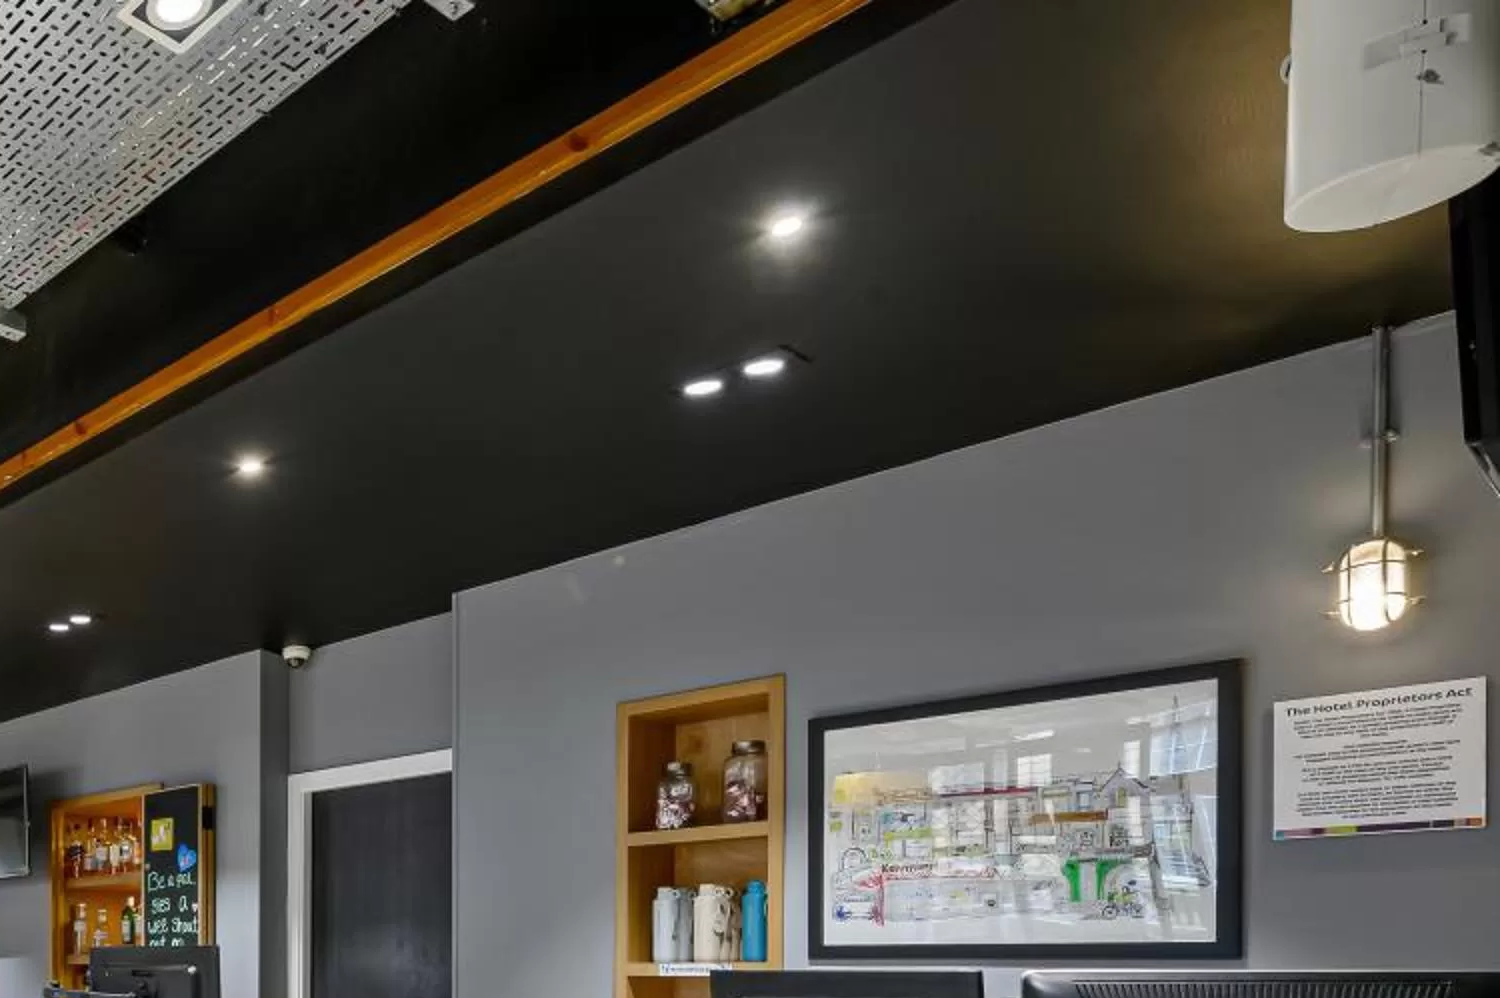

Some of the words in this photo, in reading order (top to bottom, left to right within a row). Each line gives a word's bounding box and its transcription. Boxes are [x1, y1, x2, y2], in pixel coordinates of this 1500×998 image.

[1286, 705, 1311, 717] The
[1313, 701, 1353, 715] Hotel
[1356, 692, 1443, 709] Proprietors
[1445, 687, 1473, 698] Act
